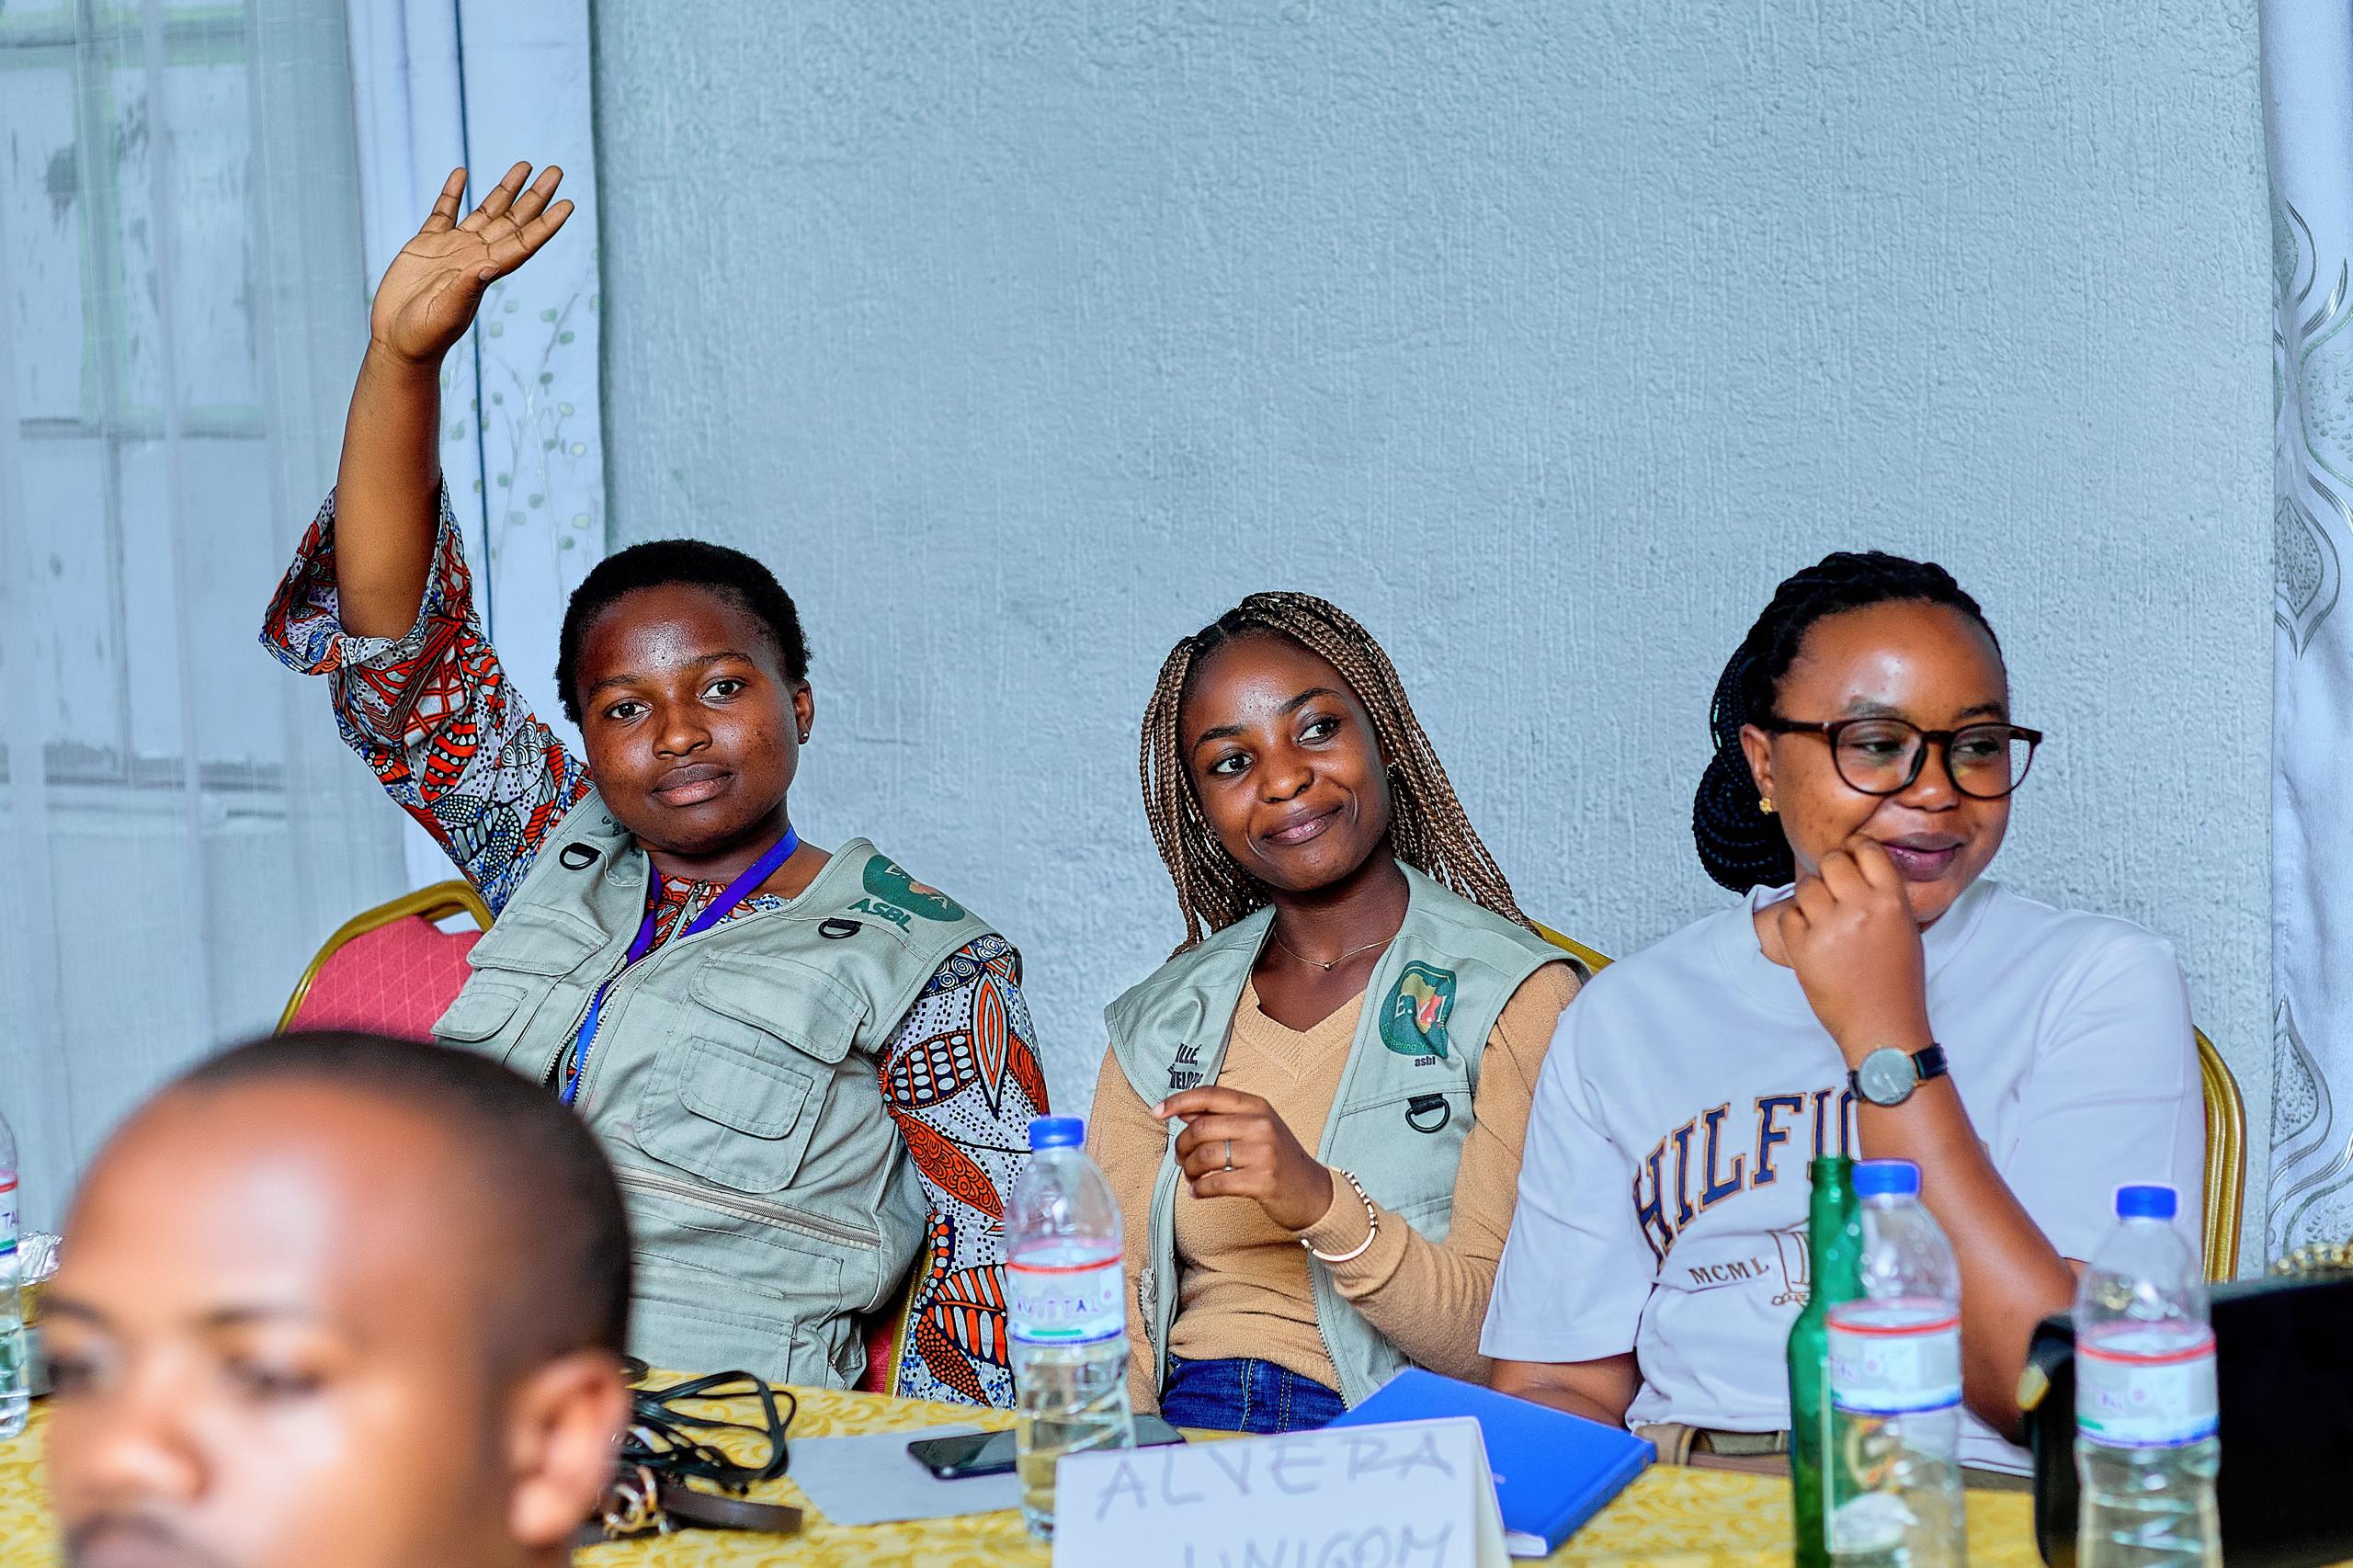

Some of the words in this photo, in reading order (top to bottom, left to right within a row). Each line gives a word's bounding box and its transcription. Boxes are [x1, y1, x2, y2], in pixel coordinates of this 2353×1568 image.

[847, 898, 911, 933] ASBL
[1415, 1056, 1436, 1067] asbl
[1688, 1257, 1769, 1285] MCML
